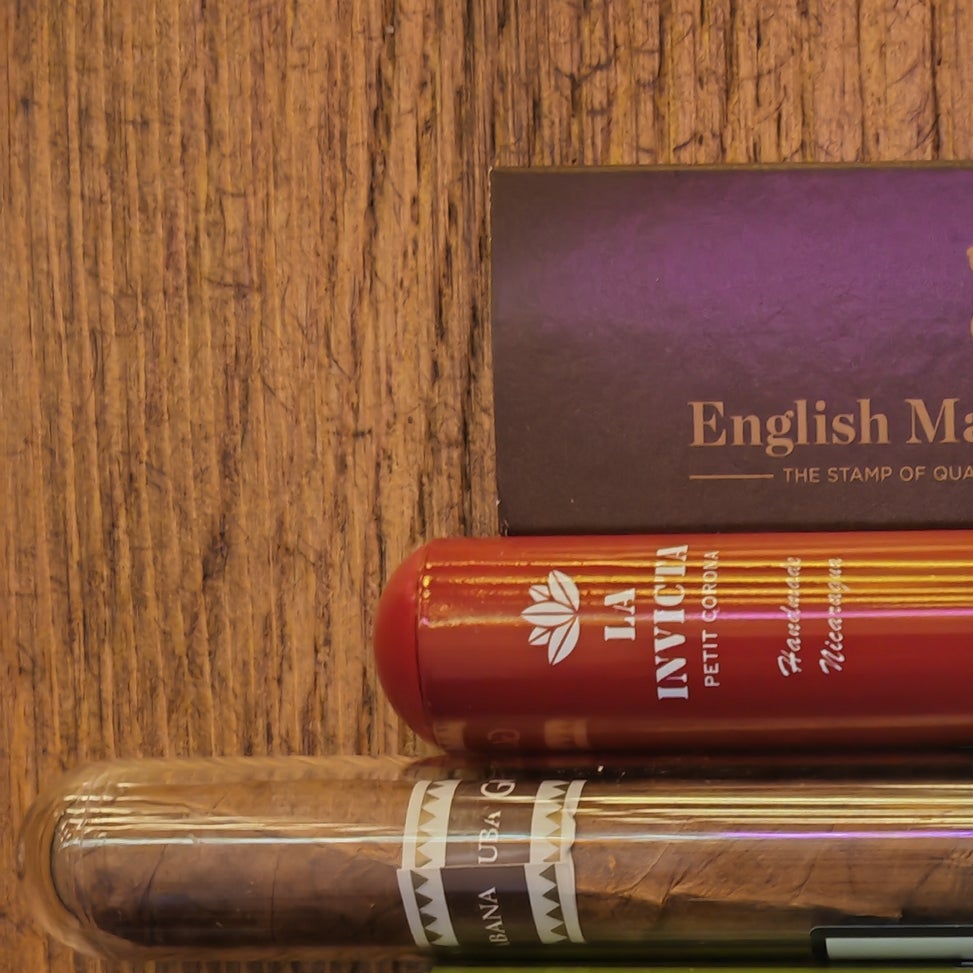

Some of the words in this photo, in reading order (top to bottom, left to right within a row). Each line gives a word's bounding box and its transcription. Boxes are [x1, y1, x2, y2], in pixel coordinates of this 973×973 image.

[689, 399, 891, 458] English
[783, 467, 821, 484] THE
[827, 465, 893, 483] STAMP
[899, 465, 926, 482] OF
[603, 587, 637, 641] LA
[701, 550, 720, 623] CORONA
[777, 556, 802, 677] Handmade
[819, 557, 849, 675] Nicaragua
[653, 544, 689, 701] INVICTA
[702, 629, 720, 687] PETIT
[478, 886, 512, 946] BANA
